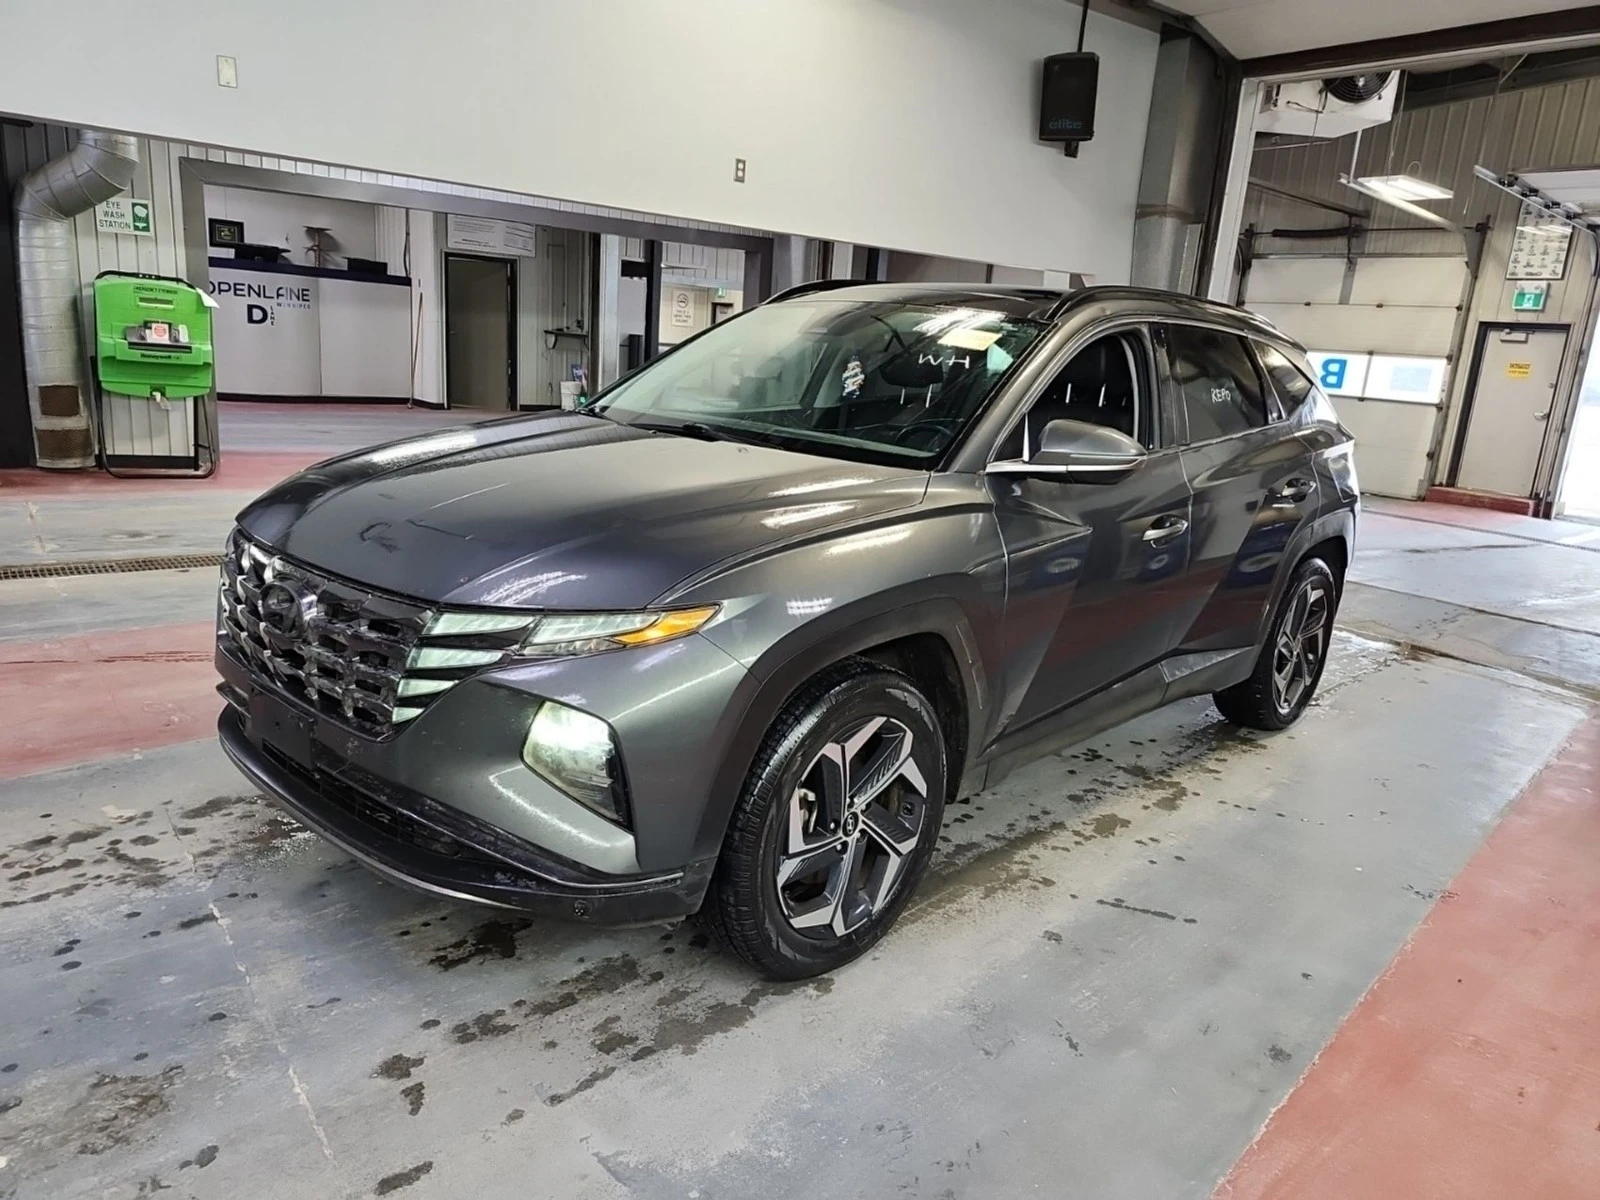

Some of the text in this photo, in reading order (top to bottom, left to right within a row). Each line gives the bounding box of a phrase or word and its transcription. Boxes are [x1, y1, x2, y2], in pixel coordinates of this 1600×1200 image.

[105, 200, 121, 209] EYE
[103, 210, 125, 219] WASH
[99, 219, 131, 229] STATION
[246, 303, 268, 325] D
